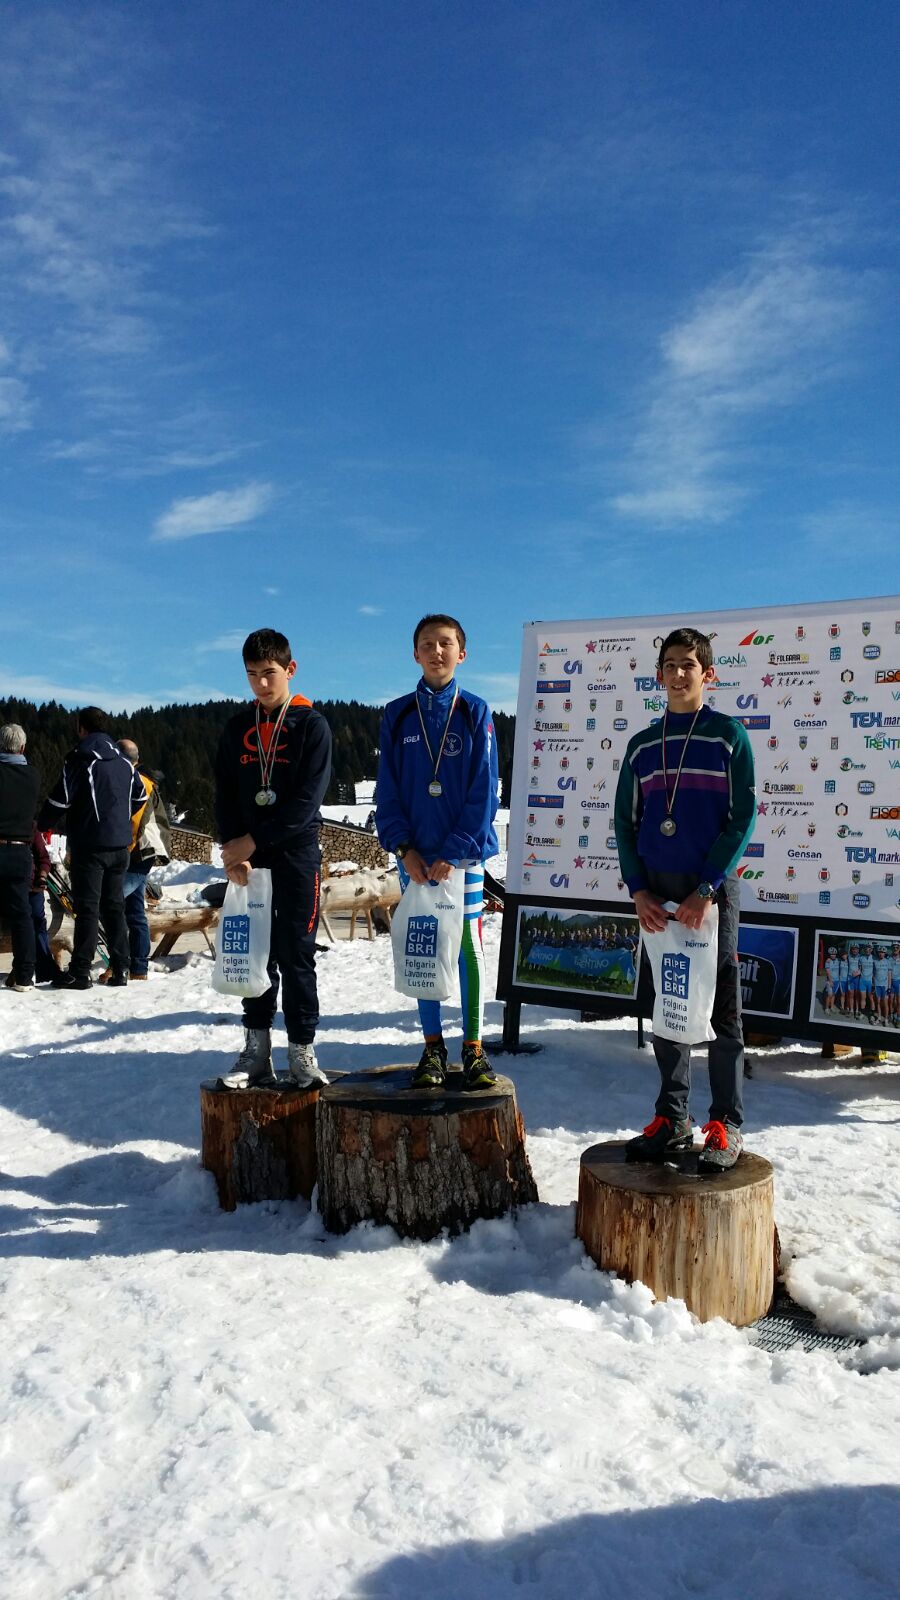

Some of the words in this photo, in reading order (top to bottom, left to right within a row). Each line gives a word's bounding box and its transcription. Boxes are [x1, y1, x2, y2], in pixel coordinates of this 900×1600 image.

[587, 683, 616, 691] Gensan
[793, 719, 827, 728] Gensan
[581, 801, 609, 809] Gensan
[788, 849, 822, 859] Gensan
[409, 921, 435, 931] ALPE
[408, 932, 435, 943] CIM
[407, 943, 434, 955] BRA
[405, 959, 436, 970] Folgaria
[404, 969, 437, 979] Lavarone
[664, 982, 685, 996] BRA
